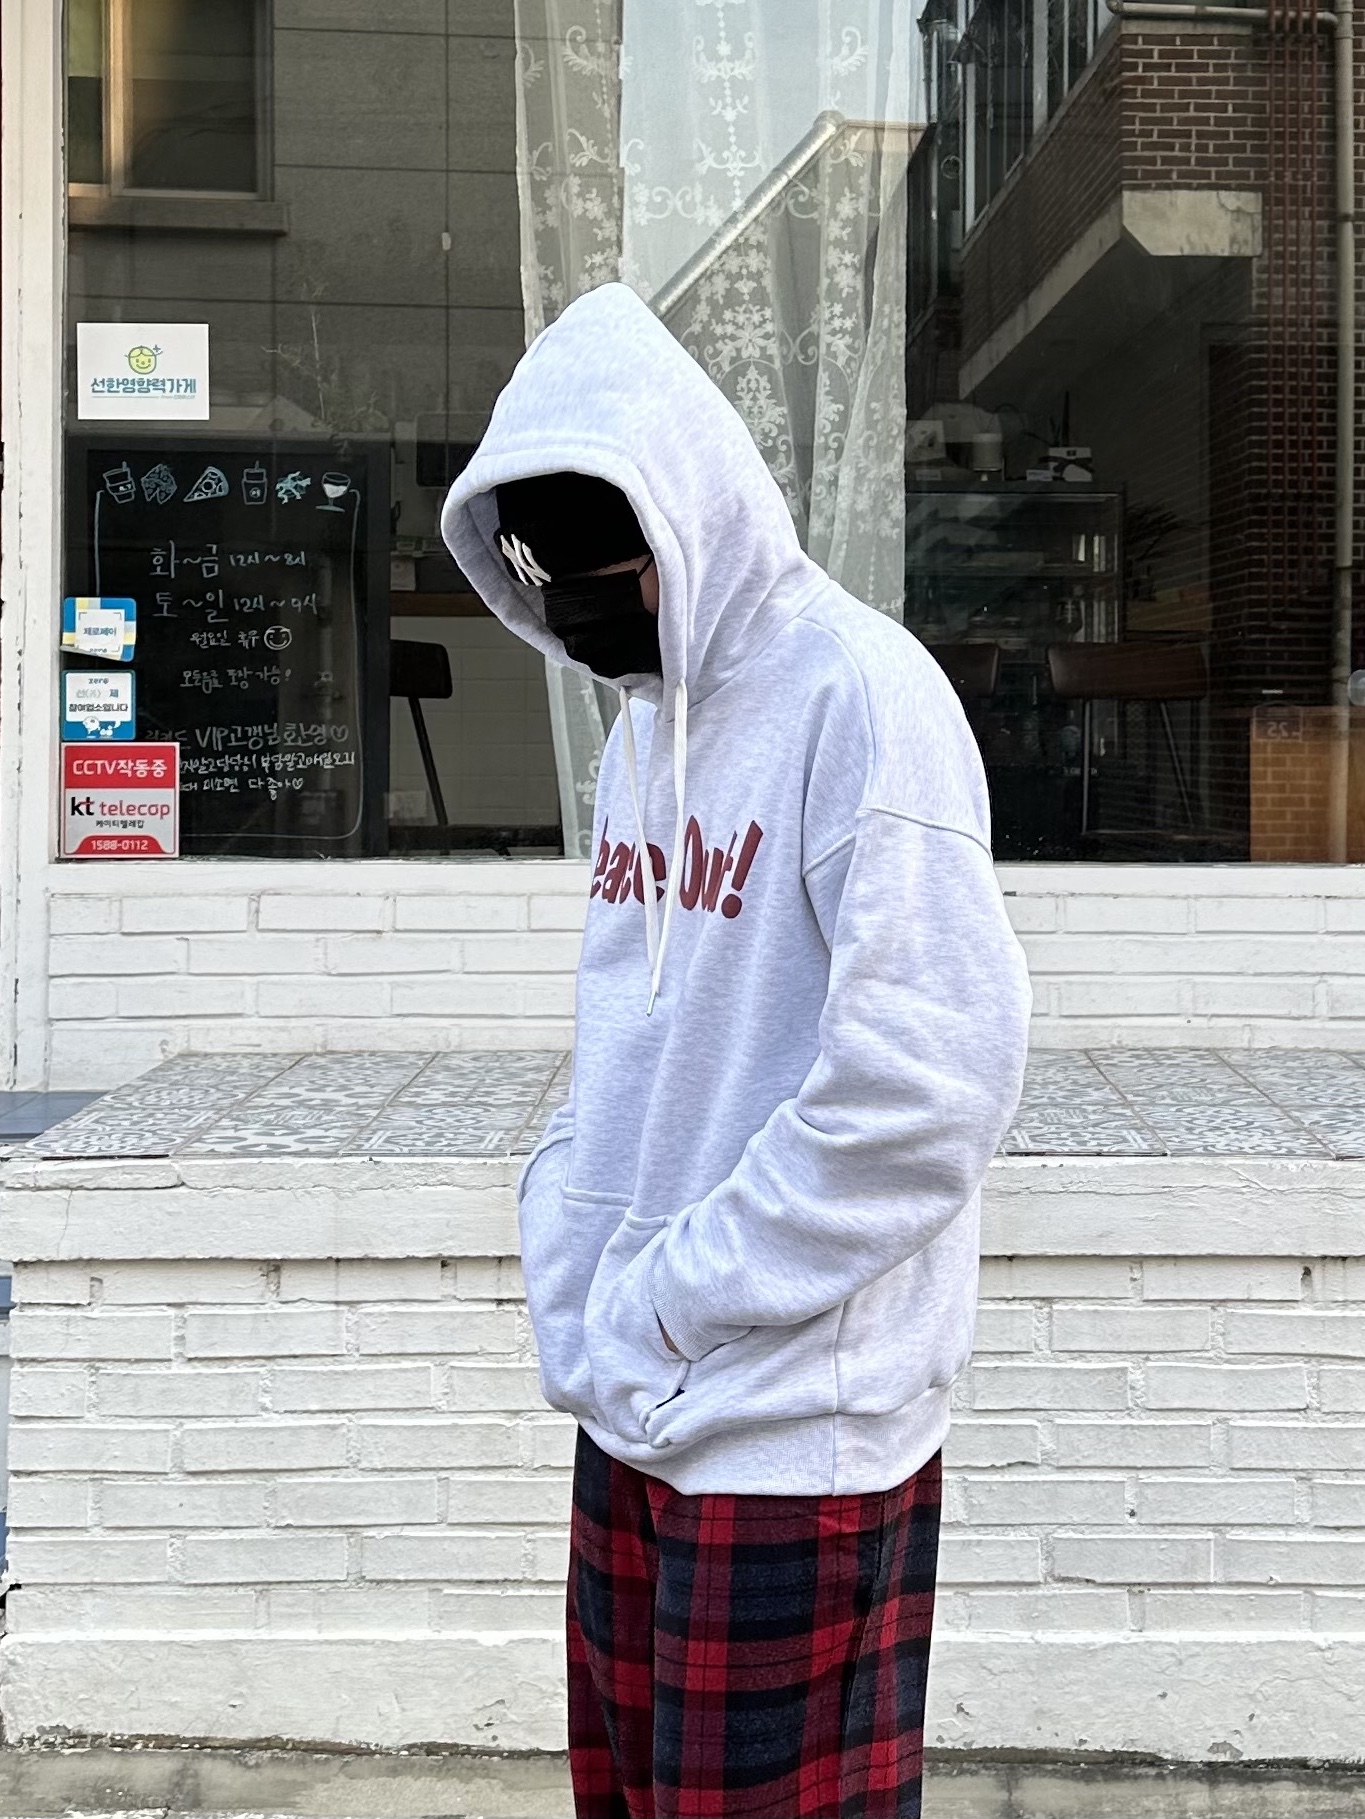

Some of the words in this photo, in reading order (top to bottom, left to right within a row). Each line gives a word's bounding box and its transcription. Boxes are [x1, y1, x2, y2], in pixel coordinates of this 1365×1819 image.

[91, 378, 197, 394] 선한영향력가게
[83, 627, 117, 636] 제로페이
[190, 630, 231, 648] 월요일
[69, 703, 129, 712] 참여업소입니다
[73, 759, 167, 777] CCTV작동중
[71, 797, 95, 816] kt
[99, 800, 170, 820] telecop
[96, 820, 145, 829] 케이티텔레캅
[91, 840, 148, 851] 1588-0112
[680, 815, 764, 919] Out!
